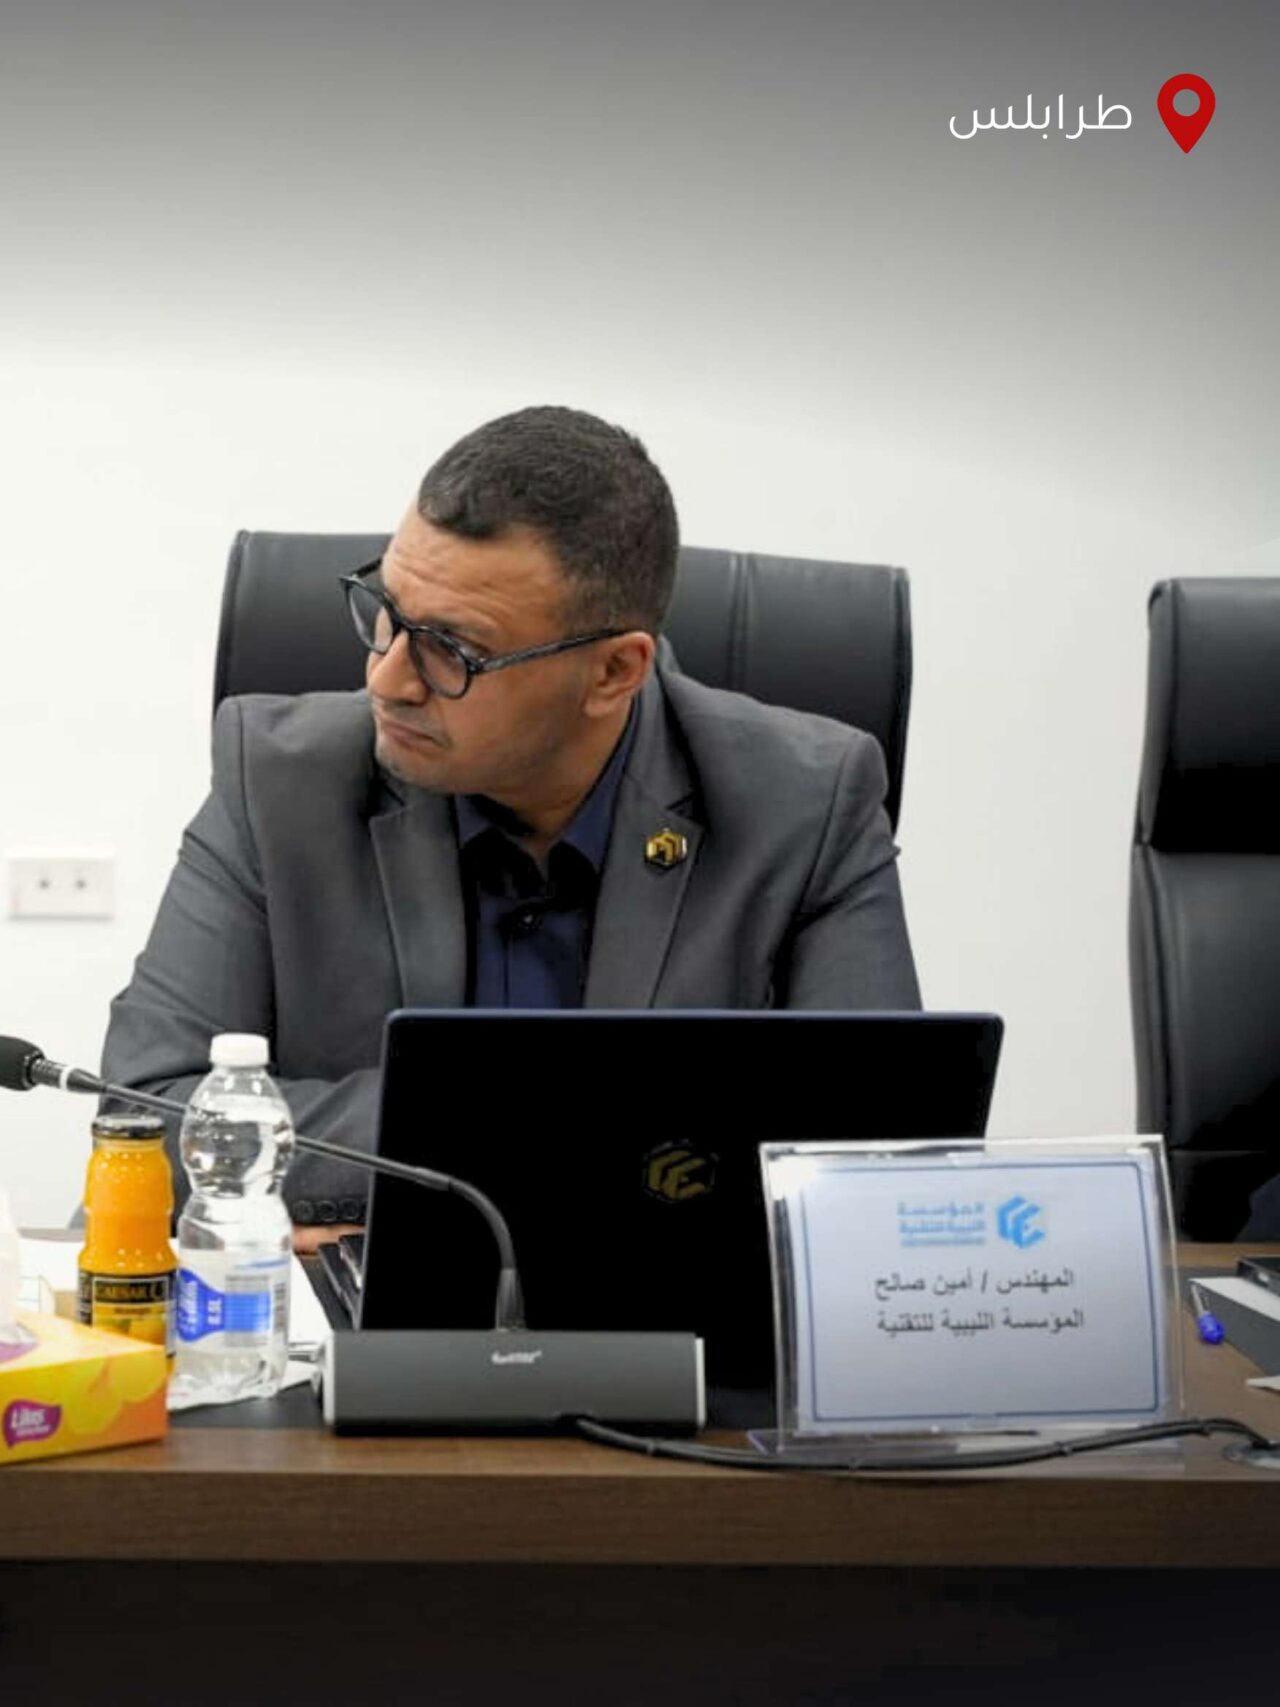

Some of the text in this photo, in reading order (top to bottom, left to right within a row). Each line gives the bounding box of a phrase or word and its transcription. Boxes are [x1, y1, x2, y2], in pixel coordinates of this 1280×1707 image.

[875, 1271, 926, 1301] صالح
[996, 1267, 1074, 1294] المهندس
[877, 1310, 934, 1338] للتقنية
[941, 1308, 994, 1337] الليبية
